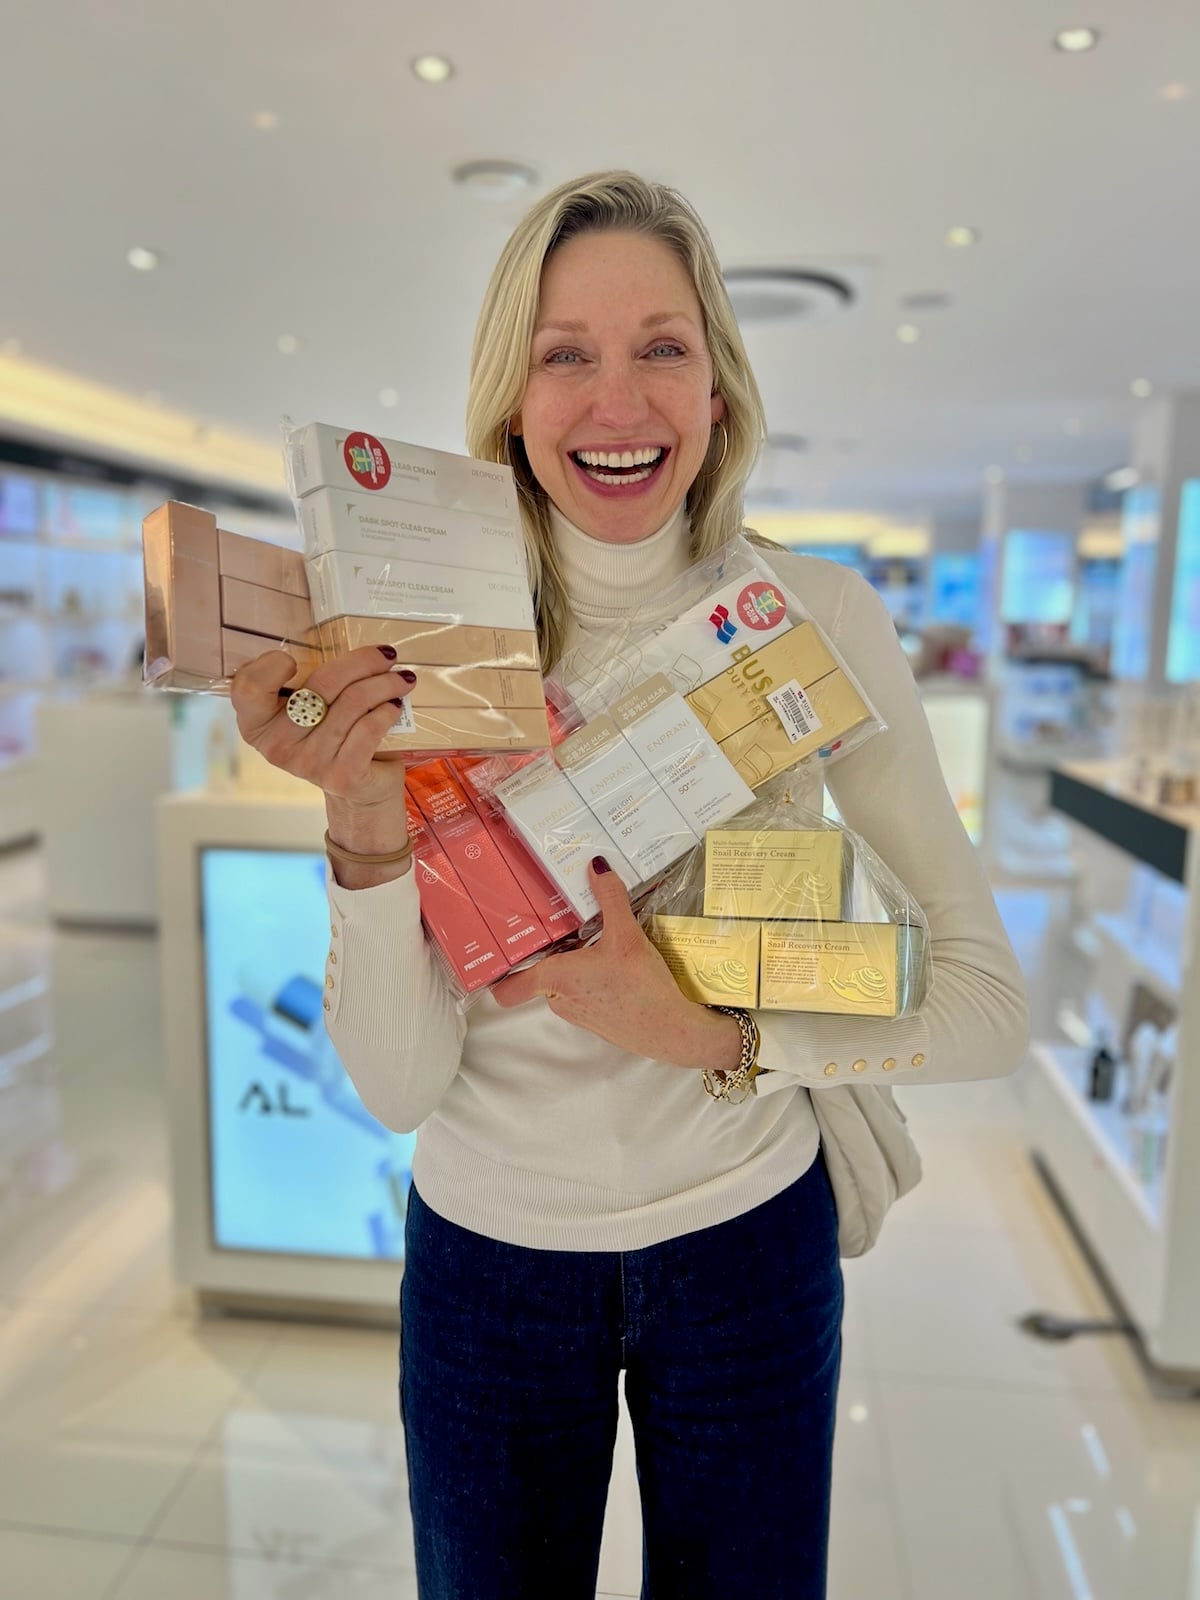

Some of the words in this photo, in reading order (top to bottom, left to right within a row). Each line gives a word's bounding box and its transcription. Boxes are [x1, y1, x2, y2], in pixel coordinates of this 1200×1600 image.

[412, 465, 436, 476] CREAM
[359, 516, 380, 525] DARK
[381, 519, 399, 528] SPOT
[400, 522, 422, 532] CLEAR
[424, 526, 447, 536] CREAM
[407, 583, 430, 592] CLEAR
[430, 585, 455, 594] CREAM
[801, 699, 815, 720] BUSAN
[646, 718, 690, 752] ENPRANI
[591, 761, 632, 795] ENPRANI
[449, 799, 460, 808] ON
[617, 795, 634, 810] LIGHT
[445, 803, 467, 817] CREAM
[712, 848, 732, 857] Snail
[733, 848, 769, 860] Recovery
[769, 849, 797, 858] Cream
[549, 905, 572, 922] PRETTYS
[661, 933, 692, 944] Recovery
[693, 935, 717, 945] Cream
[767, 941, 786, 949] Snail
[788, 941, 822, 952] Recovery
[824, 942, 850, 951] Cream
